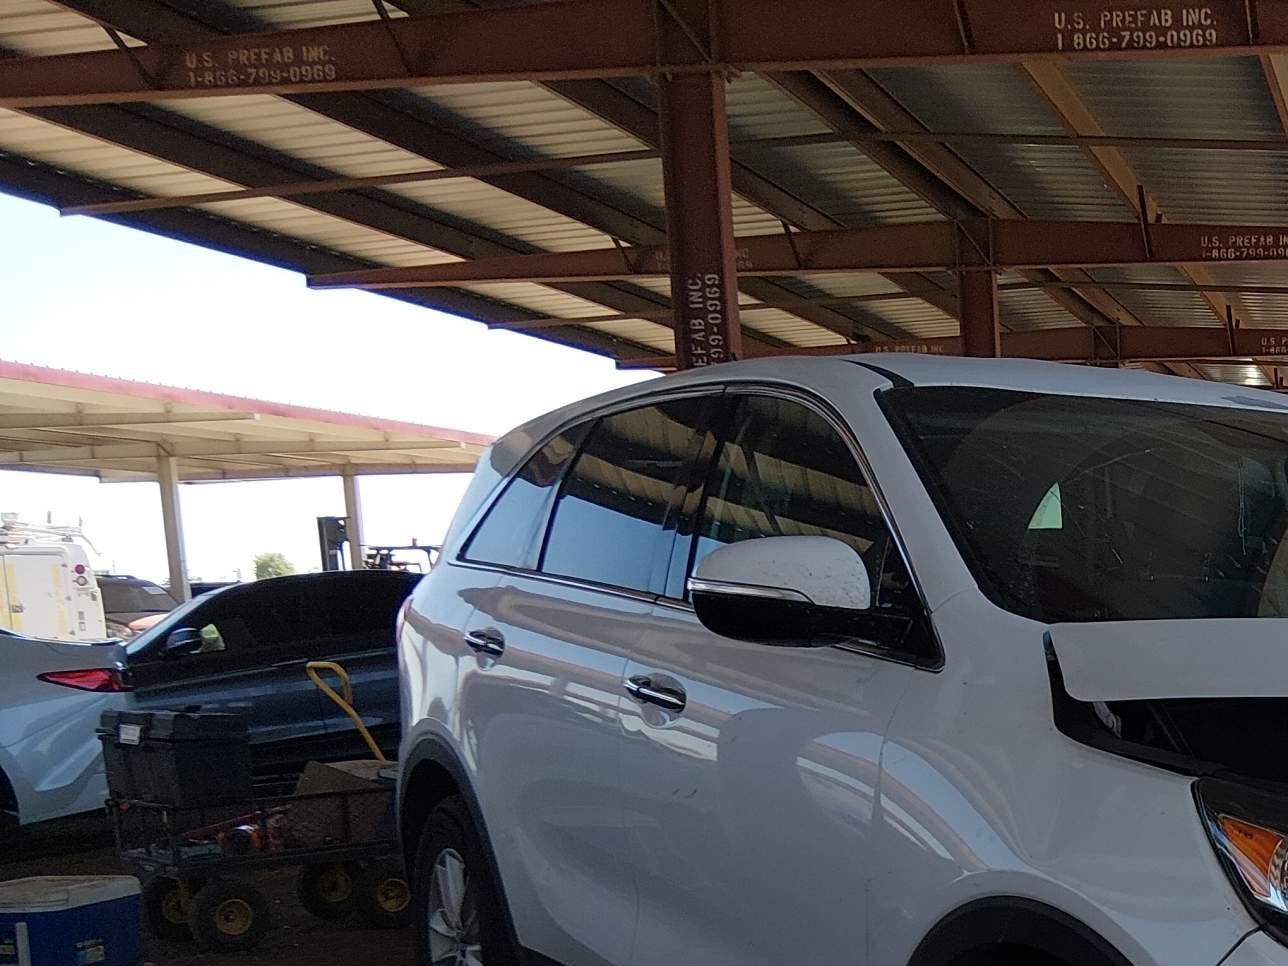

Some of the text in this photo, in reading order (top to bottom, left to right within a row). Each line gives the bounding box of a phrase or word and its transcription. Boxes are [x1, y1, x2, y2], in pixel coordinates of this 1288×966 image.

[1054, 7, 1218, 30] U.S. PREFAB INC.
[185, 45, 337, 69] U.S. PREFAB INC.
[187, 63, 337, 87] 1-866-799-0969
[1200, 235, 1224, 248] U.S.
[1228, 234, 1274, 247] PREFAB
[704, 273, 725, 367] 99-0969
